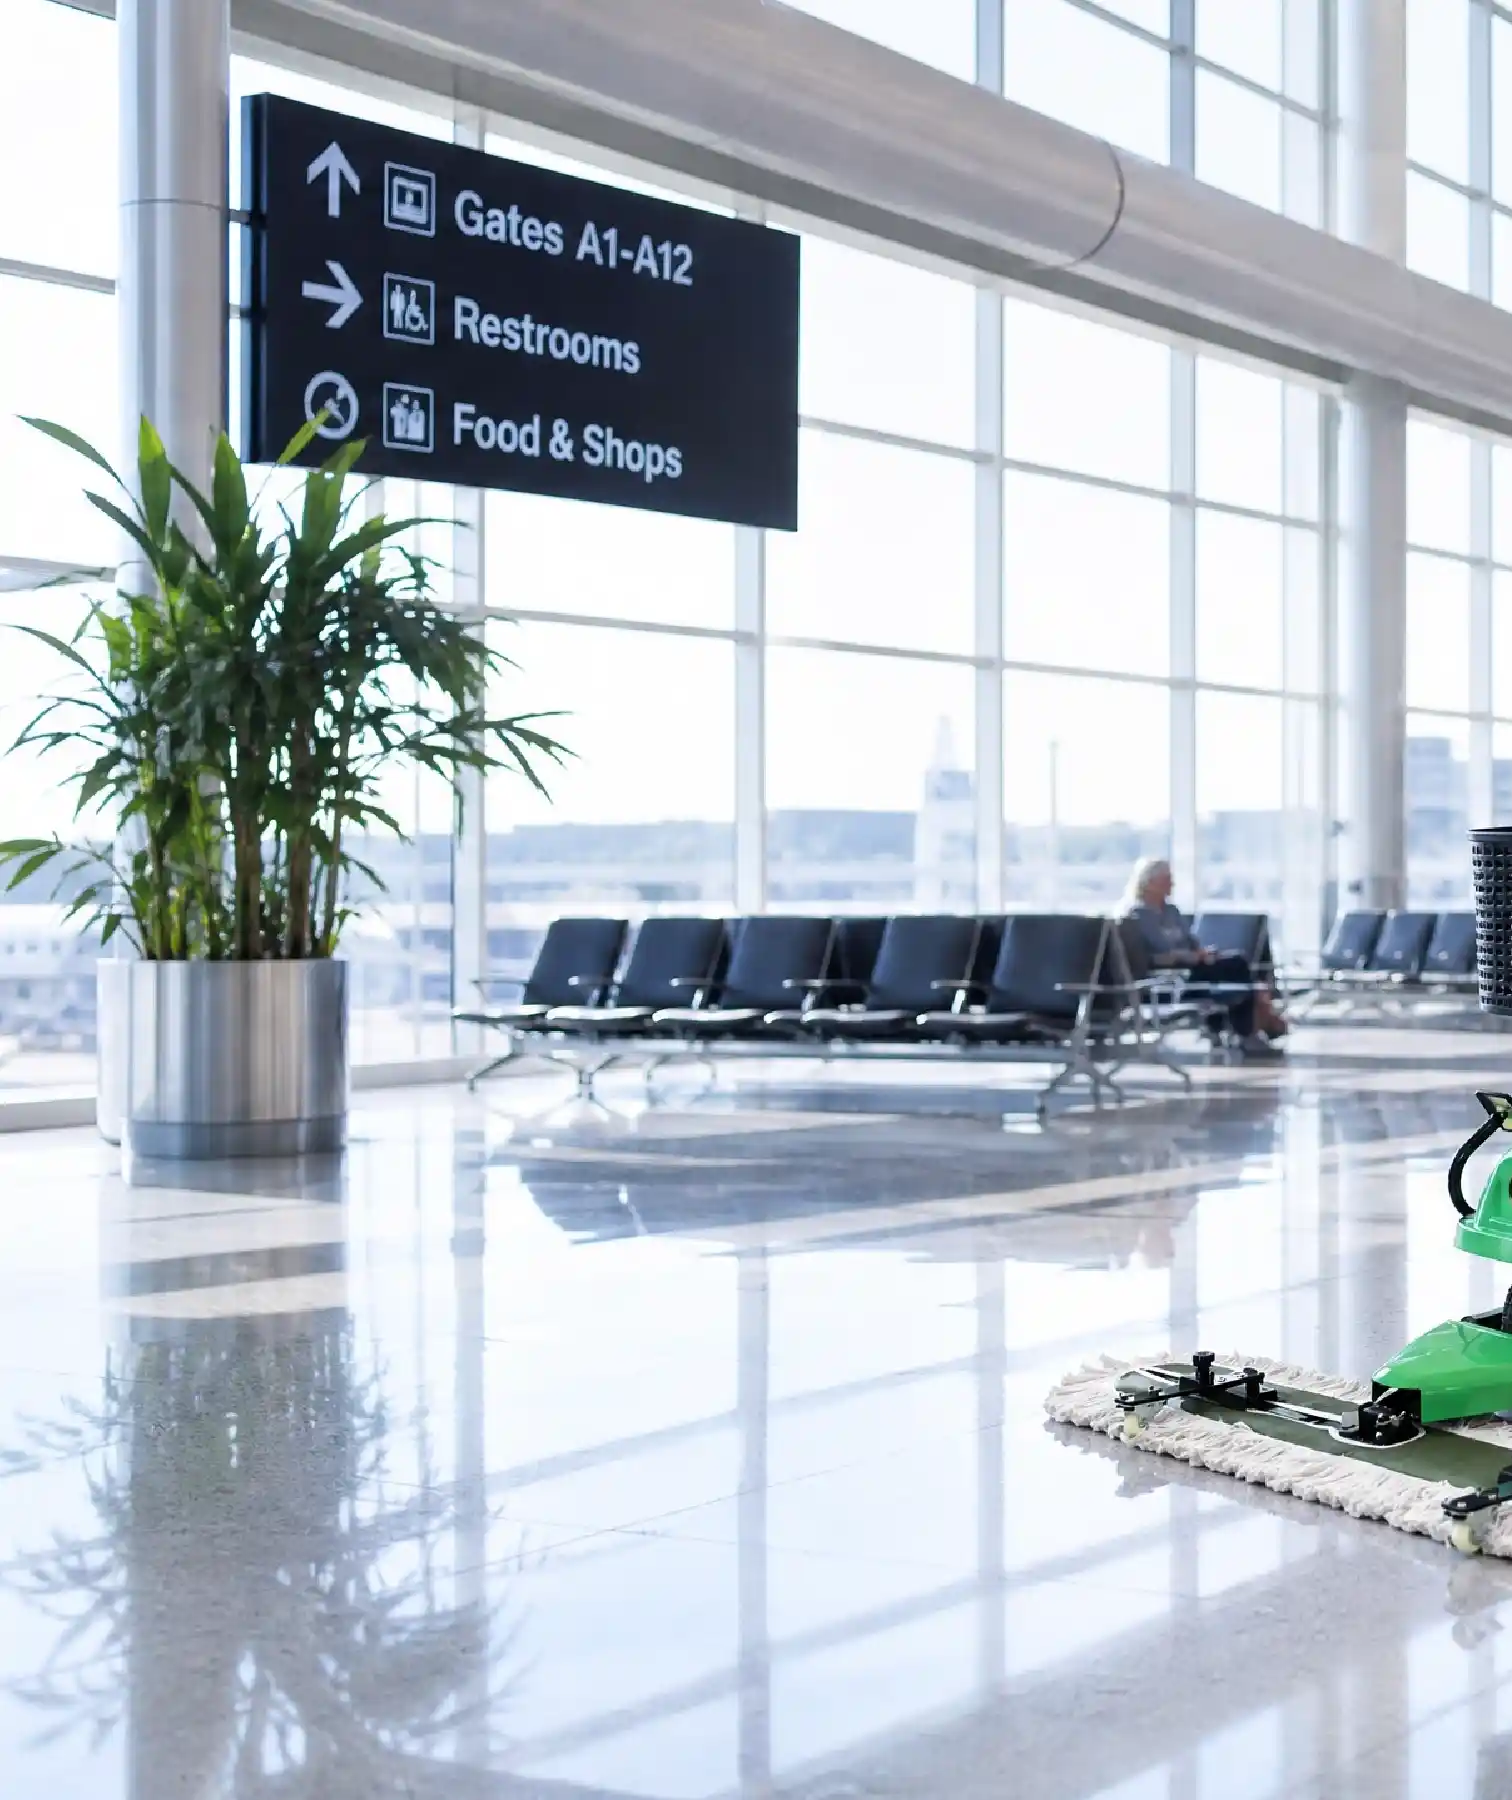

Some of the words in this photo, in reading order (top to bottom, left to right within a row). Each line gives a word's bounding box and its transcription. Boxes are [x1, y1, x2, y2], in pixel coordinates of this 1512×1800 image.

[454, 190, 564, 255] Gates
[576, 221, 694, 285] A1-A12
[454, 296, 641, 375] Restrooms
[453, 402, 541, 458] Food
[549, 418, 575, 462] &
[582, 424, 683, 482] Shops
